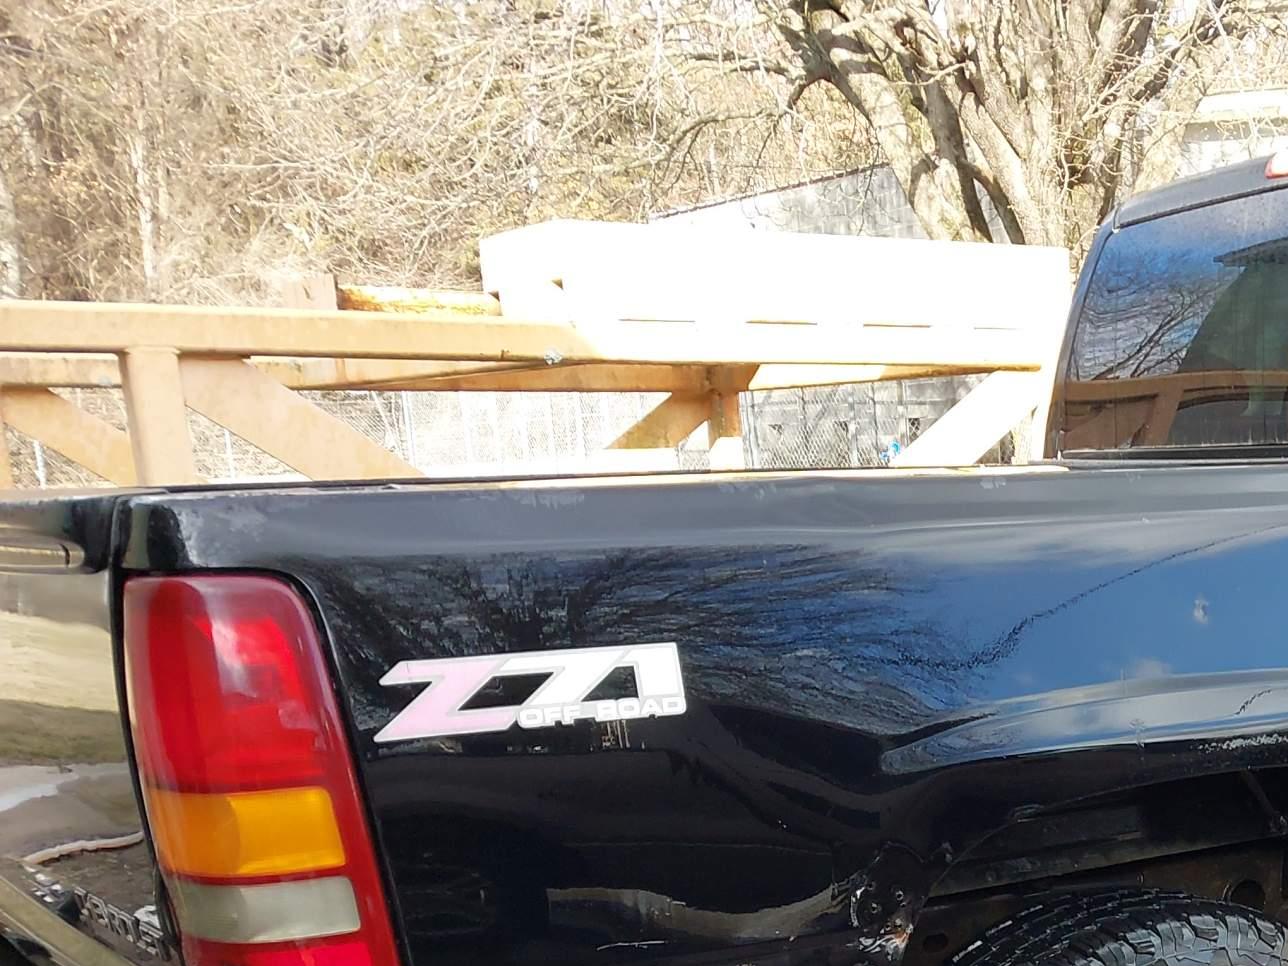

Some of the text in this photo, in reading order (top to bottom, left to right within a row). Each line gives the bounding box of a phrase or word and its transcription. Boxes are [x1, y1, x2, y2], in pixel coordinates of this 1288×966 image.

[373, 642, 687, 742] Z71
[518, 697, 687, 728] OFF ROAD
